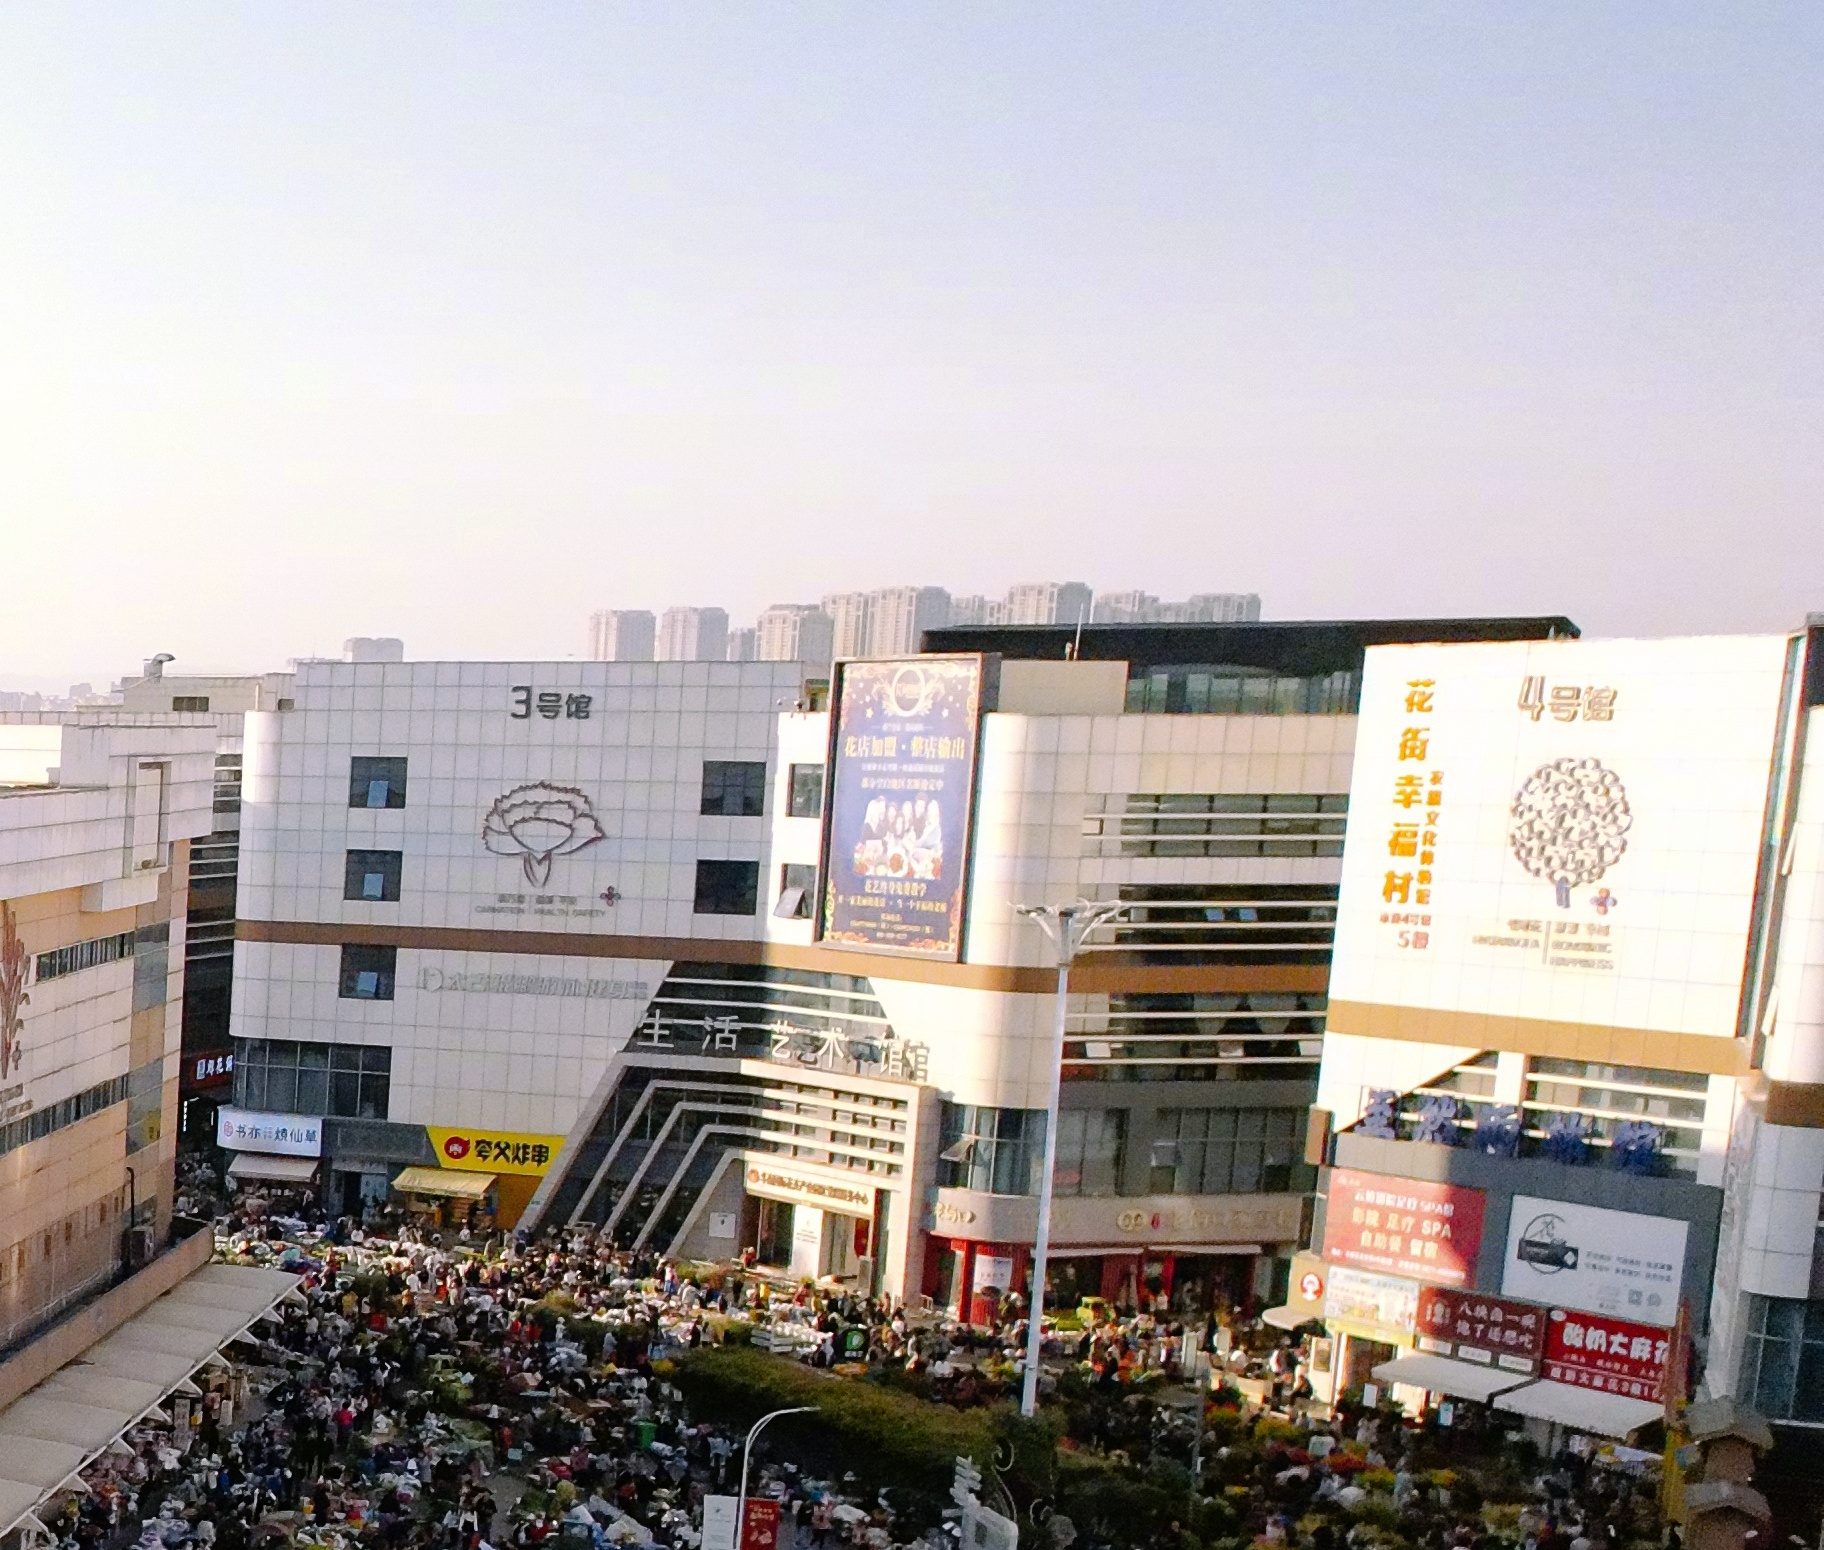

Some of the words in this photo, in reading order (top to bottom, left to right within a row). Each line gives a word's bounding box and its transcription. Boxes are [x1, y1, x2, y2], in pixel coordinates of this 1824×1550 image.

[510, 685, 593, 719] 3号馆
[1518, 675, 1618, 722] 4号馆
[1382, 679, 1436, 904] 花街幸福村
[636, 1008, 905, 1078] 生活艺术馆
[473, 1138, 550, 1168] 夸父炸串
[1421, 1219, 1453, 1238] SPA
